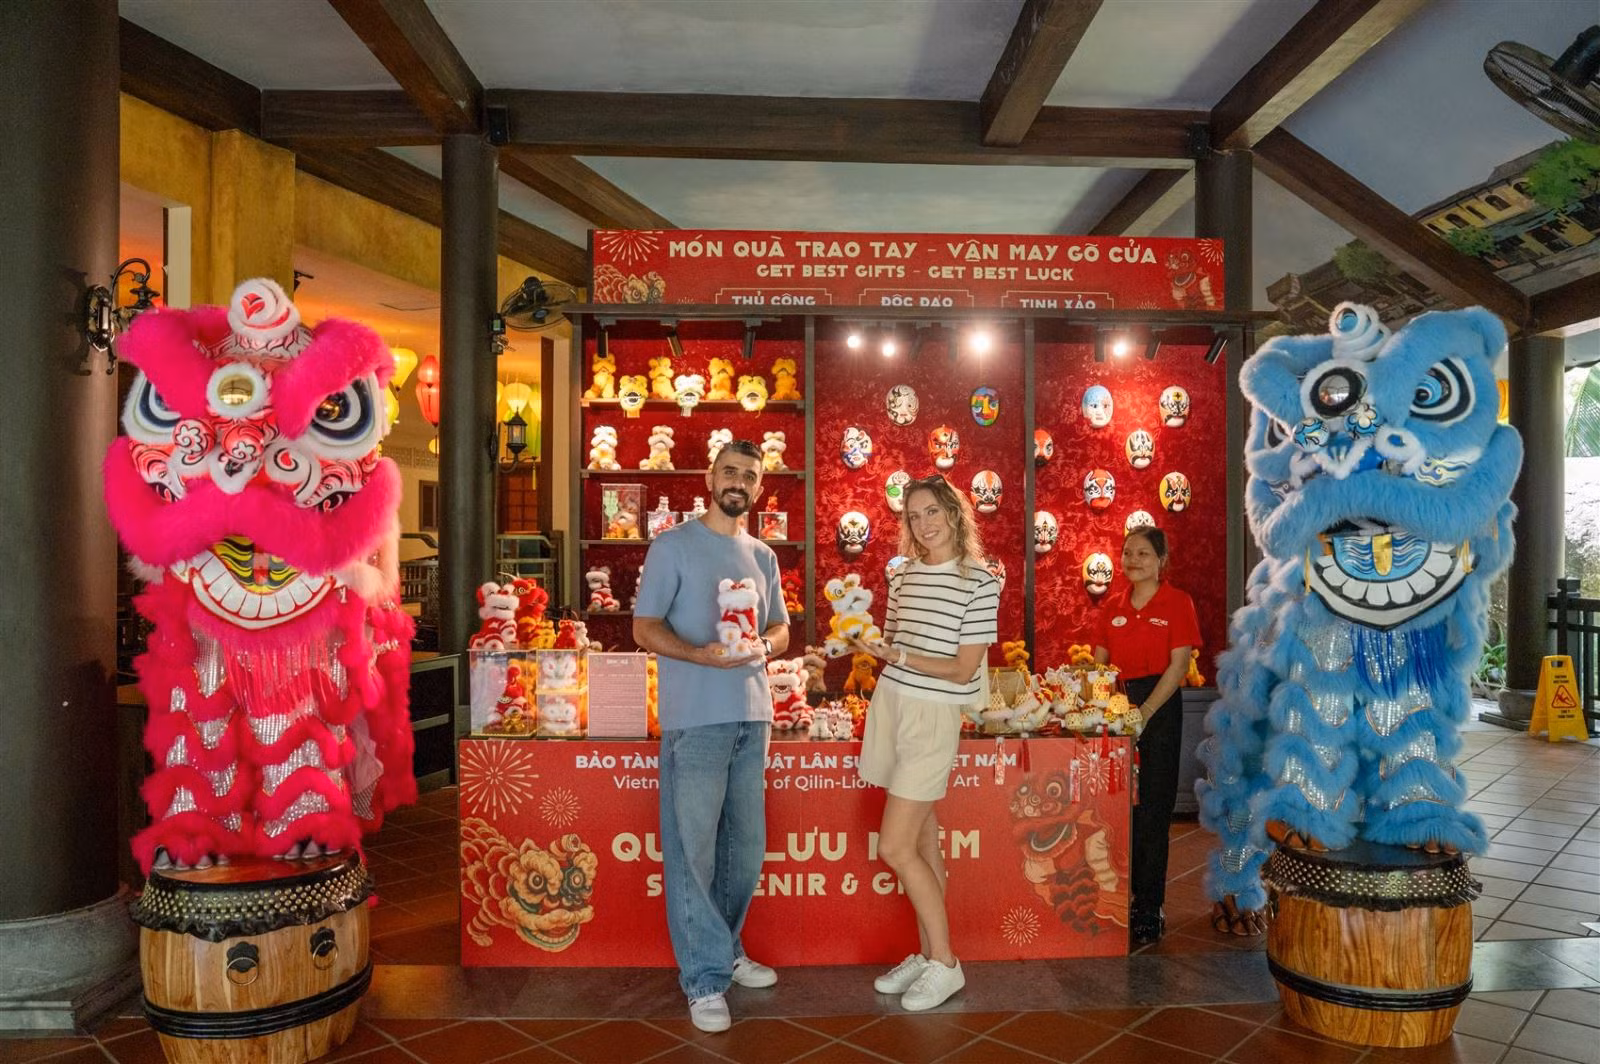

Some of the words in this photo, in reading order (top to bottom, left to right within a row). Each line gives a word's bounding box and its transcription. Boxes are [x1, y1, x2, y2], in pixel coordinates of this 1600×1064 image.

[669, 234, 723, 258] MÓN
[733, 236, 785, 258] QUÀ
[796, 241, 861, 258] TRAO
[870, 241, 918, 258] TAY
[947, 239, 999, 262] VẬN
[1009, 244, 1059, 261] MAY
[1067, 243, 1100, 262] GÕ
[1108, 239, 1157, 264] CỬA
[757, 264, 795, 277] GET
[802, 264, 848, 278] BEST
[855, 265, 906, 278] GIFTS
[928, 265, 966, 279] GET
[973, 267, 1018, 280] BEST
[1025, 268, 1074, 281] LUCK
[770, 293, 816, 305] CÔNG
[1019, 299, 1058, 309] TINH
[1064, 294, 1096, 309] XẢO
[576, 750, 617, 769] BẢO
[621, 752, 659, 769] TÀN
[800, 752, 838, 769] LÂN
[613, 775, 660, 789] Vietn
[773, 775, 791, 790] of
[794, 775, 878, 792] Qilin-Lio
[953, 773, 980, 788] Art
[611, 832, 665, 862] QU
[841, 873, 859, 896] &
